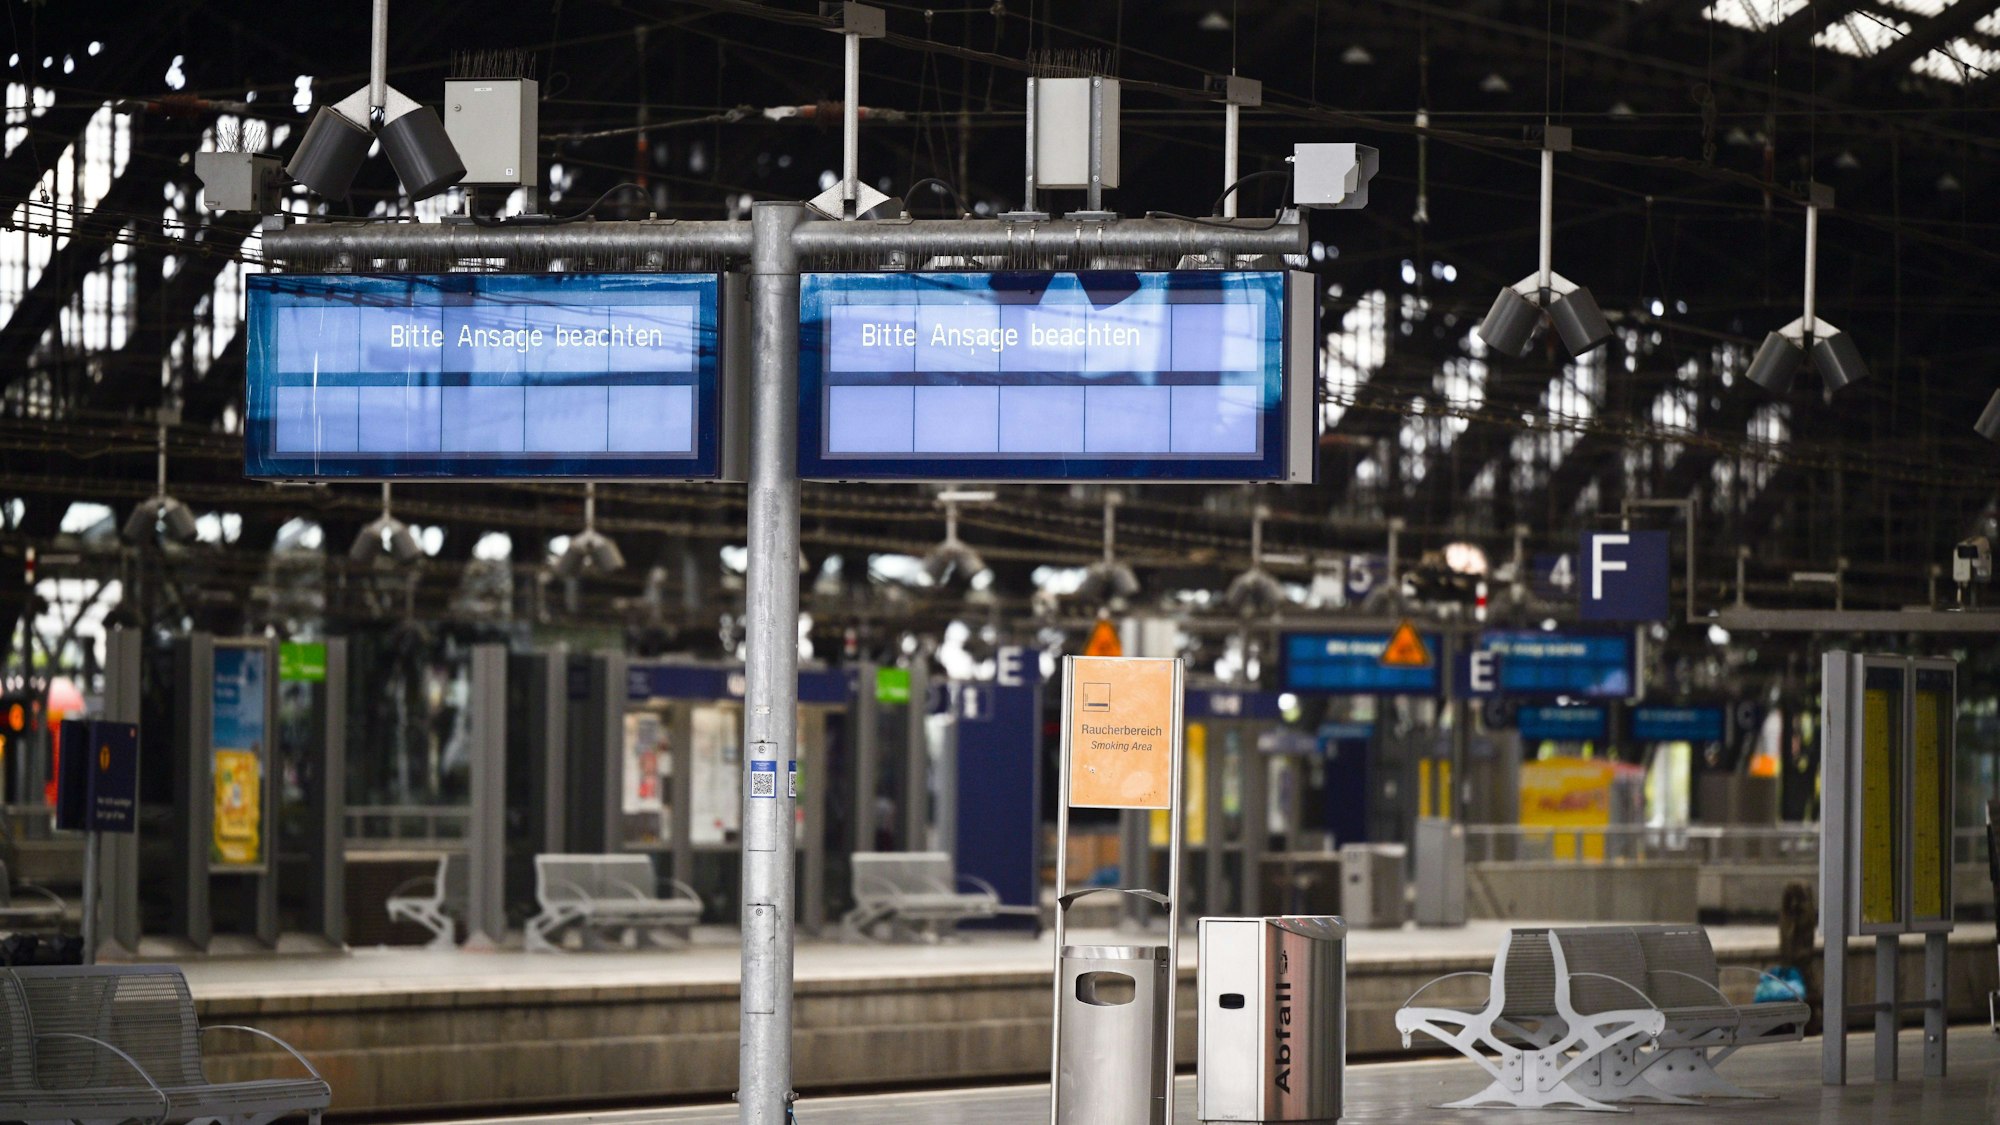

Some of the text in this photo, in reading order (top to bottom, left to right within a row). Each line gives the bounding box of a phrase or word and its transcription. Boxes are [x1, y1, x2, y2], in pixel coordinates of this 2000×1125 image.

[391, 324, 662, 353] Bitte Ansage beachten
[862, 322, 1140, 353] Bitte Ansage beachten
[1349, 554, 1372, 593] 5
[1550, 553, 1573, 592] 4
[1592, 534, 1630, 600] F
[997, 645, 1022, 686] E
[1470, 650, 1495, 692] E
[1081, 723, 1162, 736] Raucherbereich
[1091, 741, 1153, 752] Smoking Area
[1275, 983, 1291, 1094] Abfall
